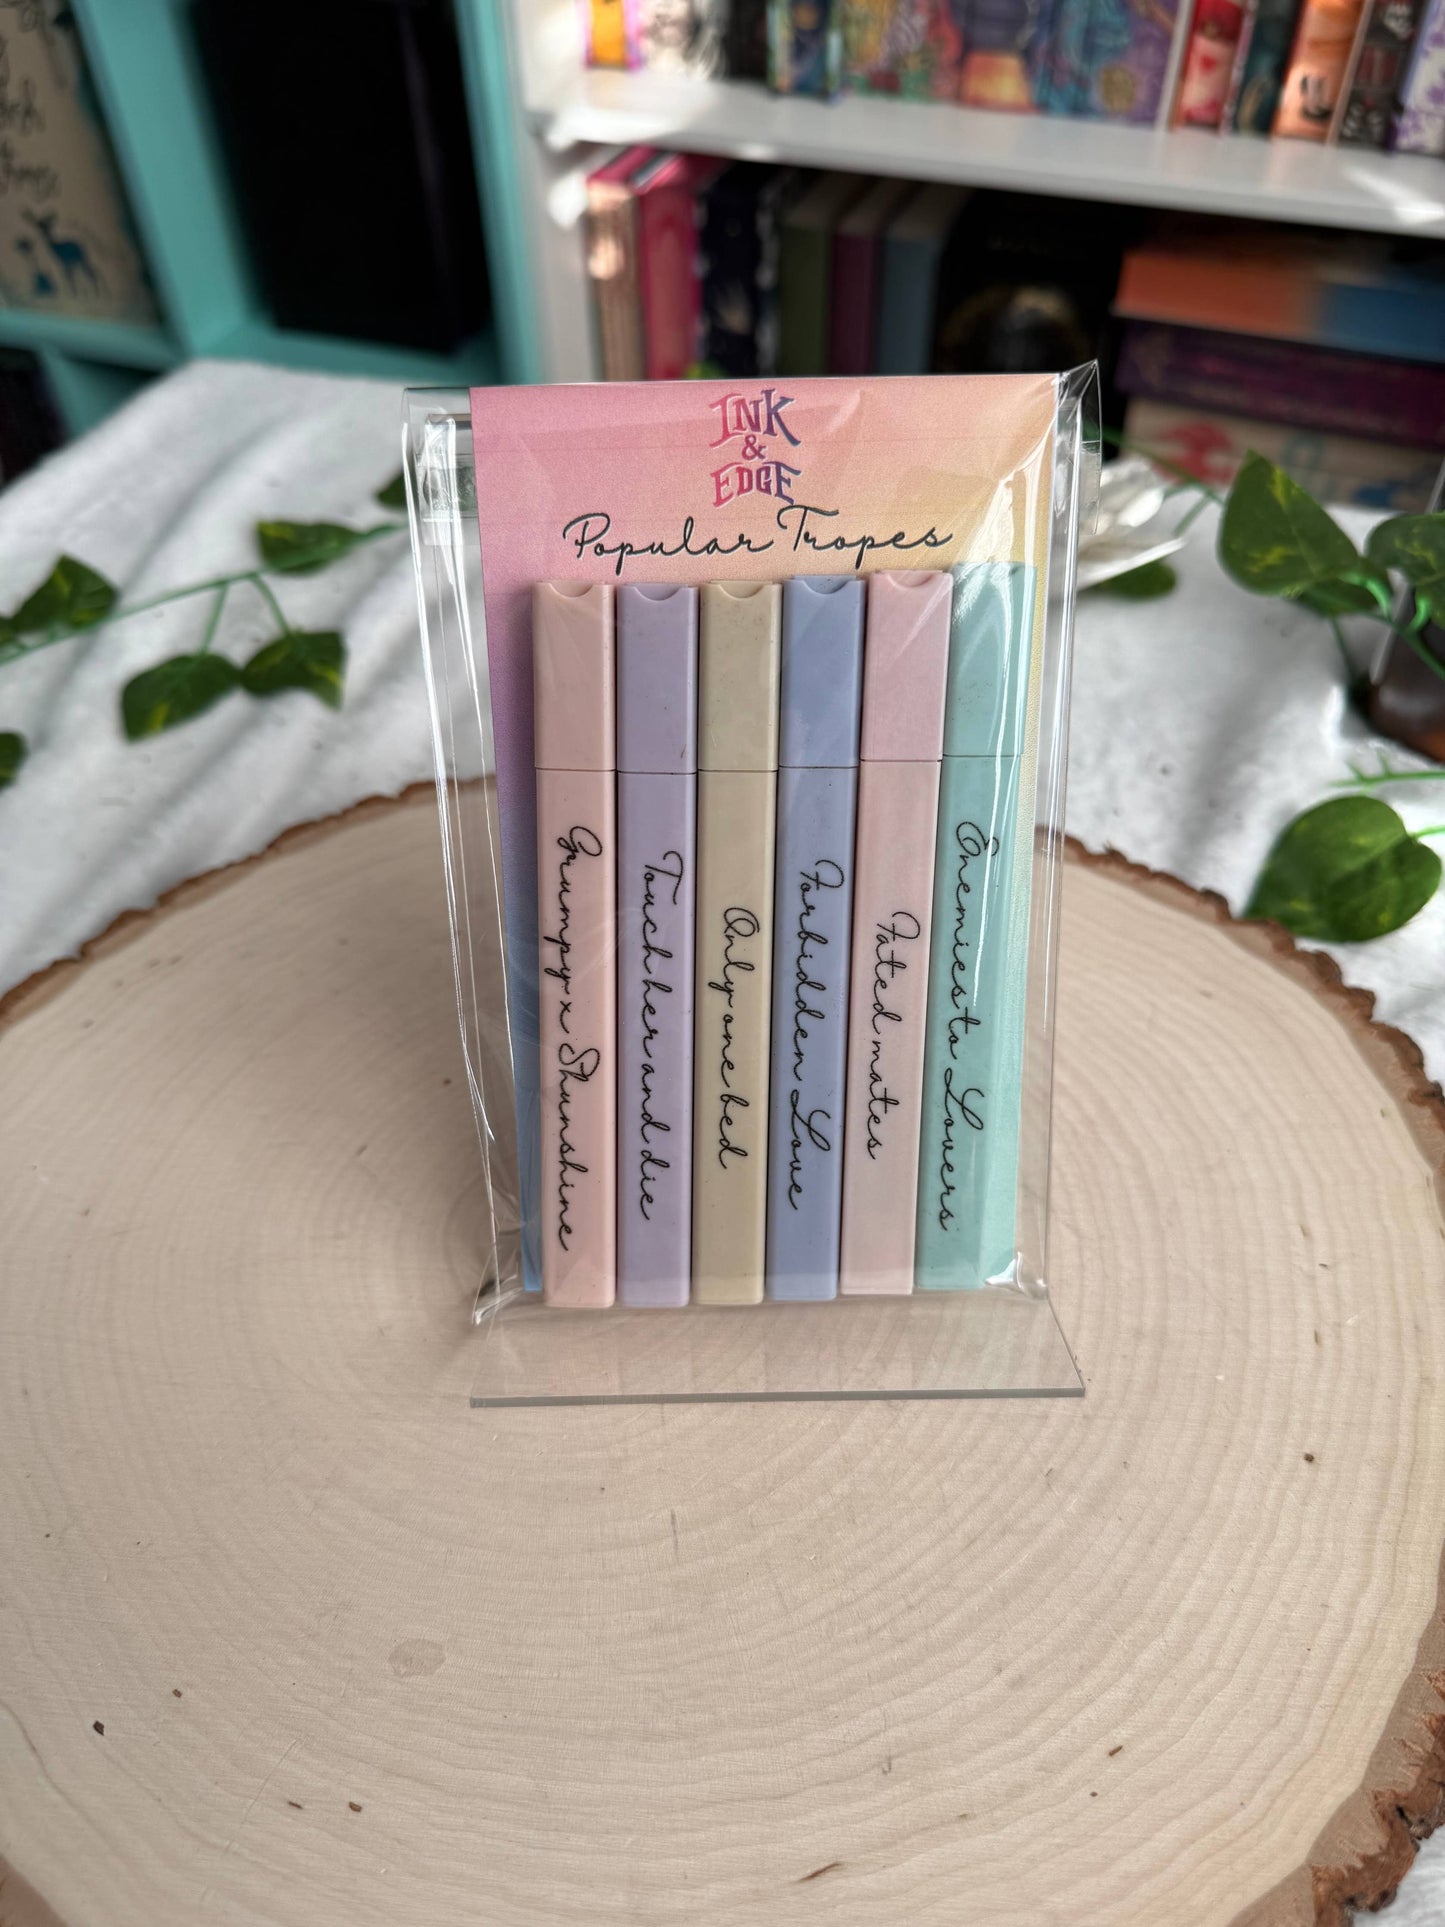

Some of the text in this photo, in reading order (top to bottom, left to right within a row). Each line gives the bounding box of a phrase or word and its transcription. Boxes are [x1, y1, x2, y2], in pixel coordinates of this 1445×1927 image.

[709, 388, 801, 448] INK
[709, 460, 801, 508] EDGE
[741, 434, 766, 461] &
[562, 505, 953, 576] Popular Tropes
[543, 825, 603, 995] Grumpy
[559, 1000, 570, 1034] x
[640, 850, 684, 1220] Touch her and die
[708, 906, 761, 1170] Only one bed
[788, 858, 845, 1210] Forbidden Love
[866, 910, 921, 1160] Fated mates
[939, 820, 1000, 1232] Enemies to Lovers
